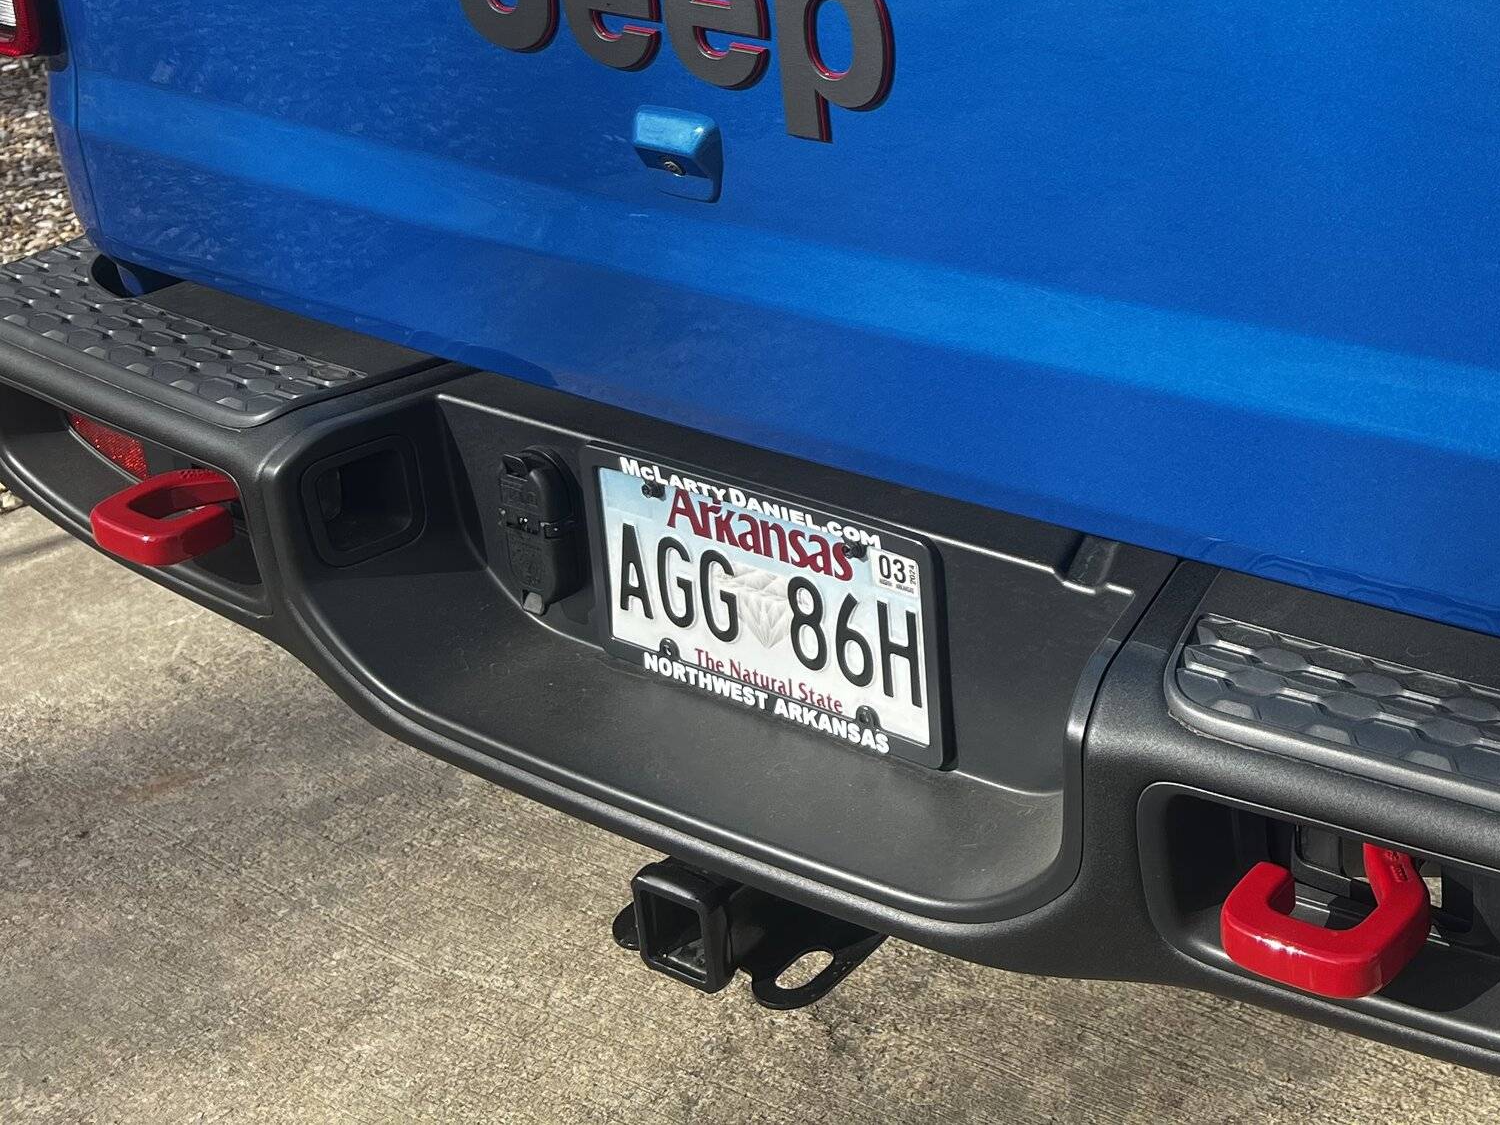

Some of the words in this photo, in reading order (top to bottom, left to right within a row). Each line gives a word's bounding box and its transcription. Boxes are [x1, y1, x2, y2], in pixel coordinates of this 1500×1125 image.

[667, 489, 853, 581] Arkansas
[878, 554, 906, 584] 03
[619, 522, 740, 643] AGG
[787, 575, 923, 708] 86H
[643, 651, 769, 709] NORTHWEST
[773, 698, 891, 754] ARKANSAS
[694, 648, 724, 673] The
[729, 658, 793, 697] Natural
[798, 683, 844, 714] State
